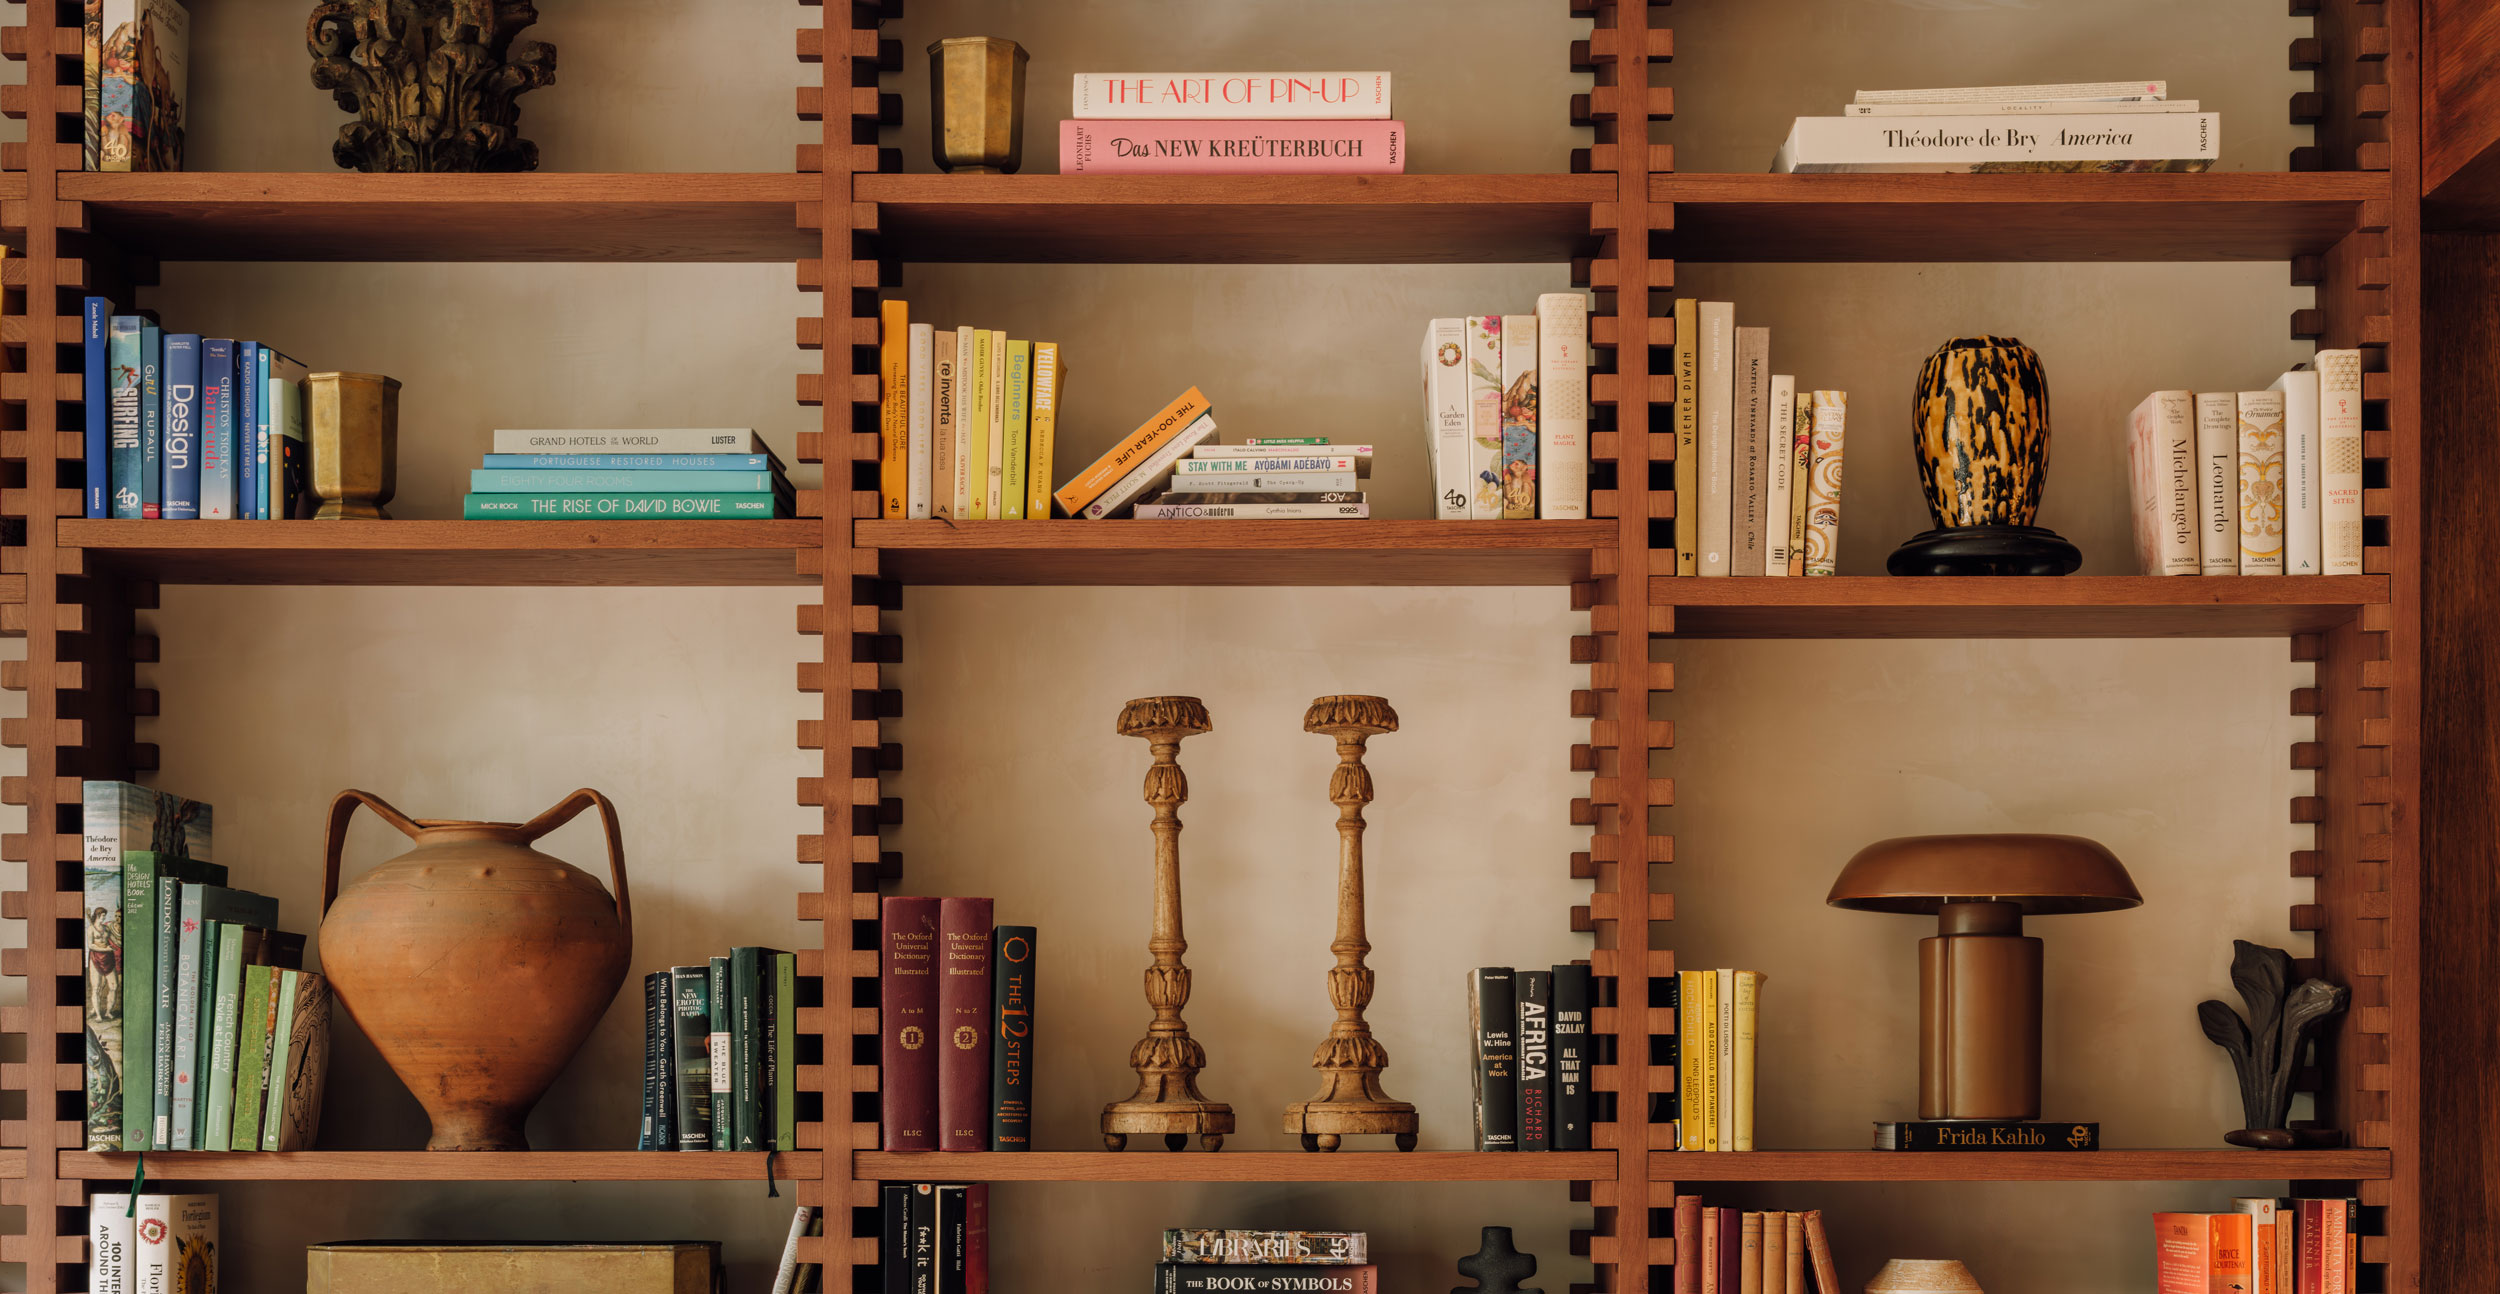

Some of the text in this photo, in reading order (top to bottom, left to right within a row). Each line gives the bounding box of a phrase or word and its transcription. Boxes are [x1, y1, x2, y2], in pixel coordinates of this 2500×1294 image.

[1104, 79, 1154, 104] THE
[1162, 79, 1216, 104] ART
[1222, 79, 1262, 104] OF
[1269, 78, 1360, 103] PIN-UP
[1110, 135, 1364, 158] Das NEW KREÜTERBUCH
[1883, 127, 2040, 153] Théodore de Bry
[2050, 128, 2133, 147] America
[2199, 118, 2208, 152] TASCHEN
[1076, 126, 1084, 172] LEONHART
[1085, 134, 1093, 162] FUCHS
[1389, 131, 1397, 165] TASCHEN
[1011, 354, 1025, 421] Beginners
[1035, 348, 1054, 411] YELLOWFACE
[1683, 351, 1692, 446] WIENER DIWAN
[112, 387, 139, 449] SURFING
[166, 385, 194, 469] Design
[205, 385, 220, 470] Barracuda
[220, 376, 230, 479] CHRISTOS TSIOLKAS
[1444, 419, 1462, 427] Eden
[146, 410, 155, 462] RUPAUL
[530, 436, 566, 446] GRAND
[569, 436, 606, 446] HOTELS
[622, 436, 659, 446] WORLD
[711, 435, 736, 445] LUSTER
[1779, 425, 1787, 460] SECRET
[533, 457, 715, 466] PORTUGUESE RESTORED HOUSES
[1009, 447, 1018, 486] Vanderbilt
[1188, 461, 1248, 472] STAY WITH ME
[500, 476, 633, 487] EIGHTY FOUR ROOMS
[958, 476, 966, 495] SACKS
[1777, 463, 1785, 491] CODE
[1444, 488, 1467, 507] 40
[2170, 439, 2191, 545] Michelangelo
[2212, 454, 2229, 533] Leonardo
[531, 499, 721, 514] THE RISE OF DAVID BOWIE
[735, 502, 765, 510] TASCHEN
[86, 835, 118, 843] Théodore
[163, 880, 173, 934] LONDON
[892, 932, 933, 941] The Oxford
[896, 942, 929, 950] Universal
[947, 932, 988, 941] The Oxford
[951, 942, 984, 950] Universal
[894, 952, 931, 962] Dictionary
[949, 952, 986, 962] Dictionary
[894, 967, 929, 975] Illustrated
[949, 967, 984, 976] Illustrated
[162, 984, 170, 1009] AIR
[1009, 974, 1022, 1005] THE
[176, 954, 190, 1060] BOTANICAL ART
[1558, 1011, 1582, 1021] DAVID
[1686, 980, 1694, 1046] HOCHSCHILD
[212, 995, 226, 1070] Style at Home
[220, 993, 236, 1073] French Country
[1000, 1004, 1029, 1040] 12
[1555, 1023, 1585, 1034] SZALAY
[1487, 1031, 1508, 1039] Lewis
[1524, 1001, 1546, 1081] AFRICA
[1006, 1040, 1020, 1086] STEPS
[1483, 1053, 1513, 1061] America
[1560, 1060, 1581, 1070] THAT
[1563, 1048, 1577, 1058] ALL
[1562, 1072, 1579, 1083] MAN
[1566, 1085, 1575, 1095] IS
[1692, 1078, 1700, 1121] LEOPOLD'S
[1524, 1089, 1533, 1141] DOWDEN
[1534, 1089, 1542, 1140] RICHARD
[1937, 1127, 2045, 1145] Frida Kahlo
[2332, 1207, 2342, 1266] AMINATTA
[99, 1225, 109, 1276] AROUND
[111, 1241, 122, 1263] 100
[2218, 1249, 2240, 1260] BRYCE
[1205, 1277, 1256, 1290] BOOK
[1271, 1277, 1353, 1290] SYMBOLS
